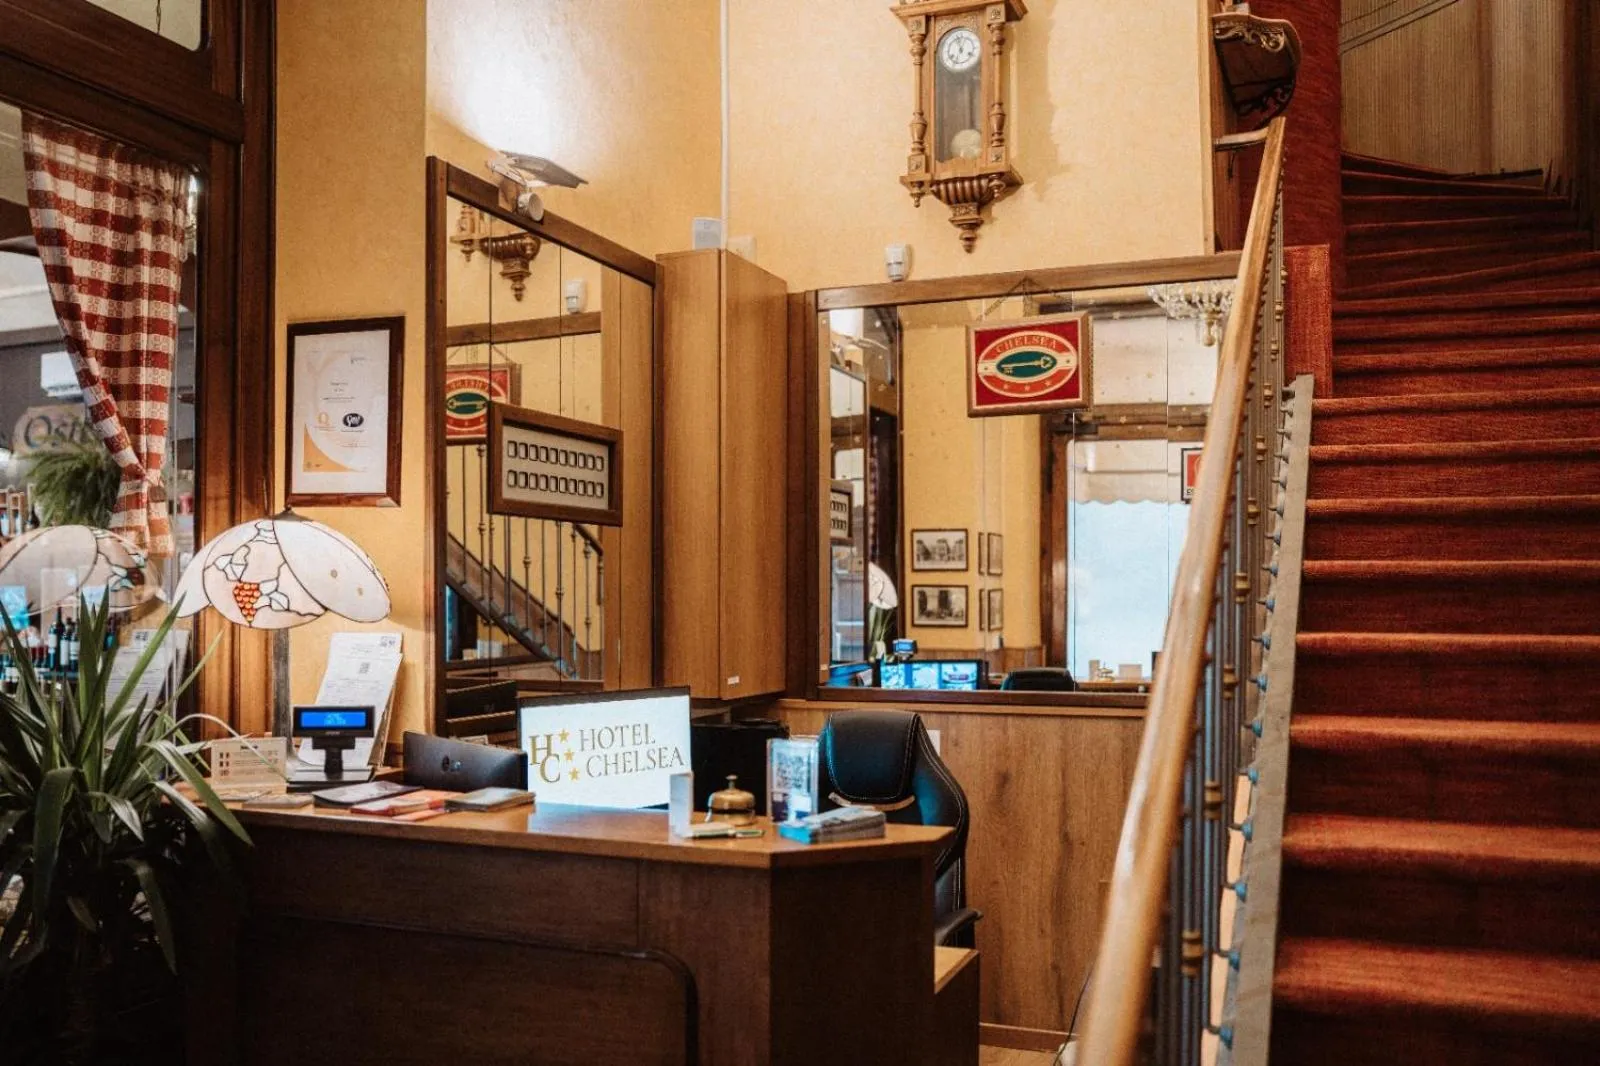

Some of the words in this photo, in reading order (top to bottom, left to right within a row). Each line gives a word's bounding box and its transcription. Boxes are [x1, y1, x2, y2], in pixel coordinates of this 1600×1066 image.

[995, 334, 1057, 354] CHELSEA
[578, 723, 656, 752] HOTEL
[586, 746, 684, 778] CHELSEA
